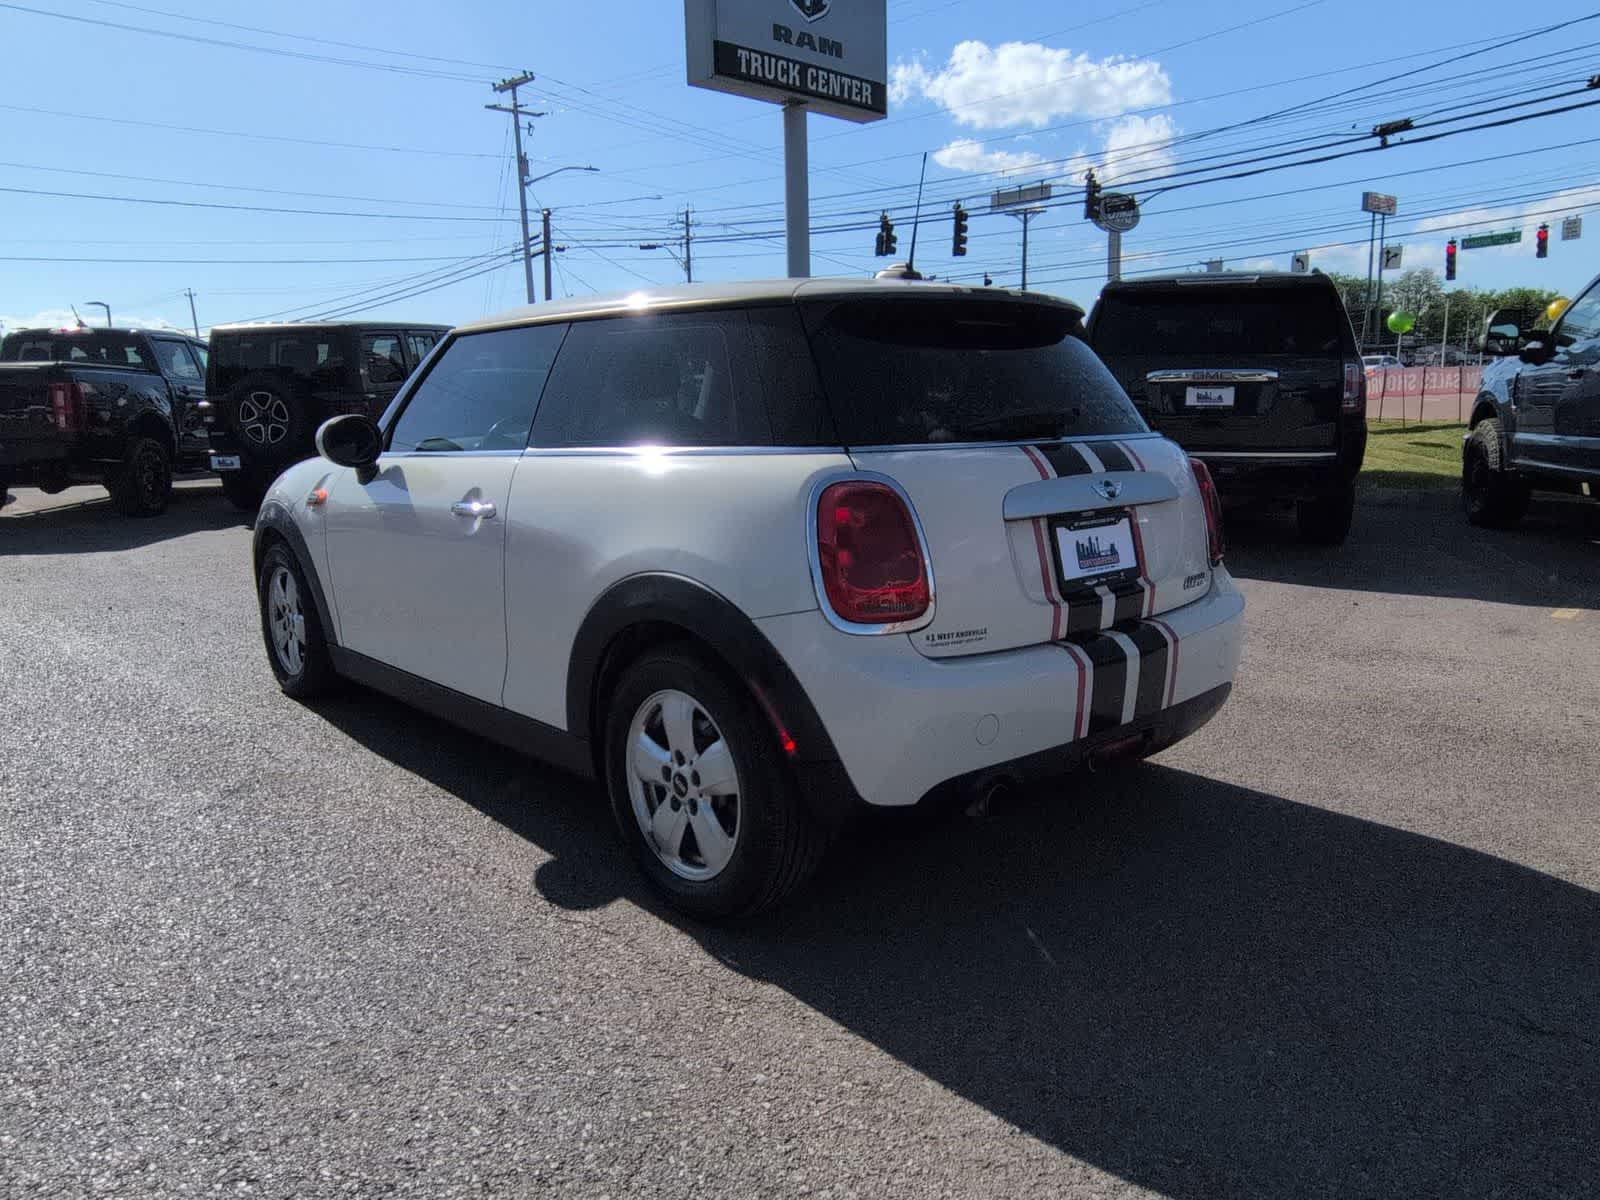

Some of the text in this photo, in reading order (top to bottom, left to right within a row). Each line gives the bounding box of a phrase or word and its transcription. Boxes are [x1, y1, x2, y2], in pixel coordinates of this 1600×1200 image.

[772, 23, 843, 59] RAM
[737, 48, 873, 105] TRUCK CENTER
